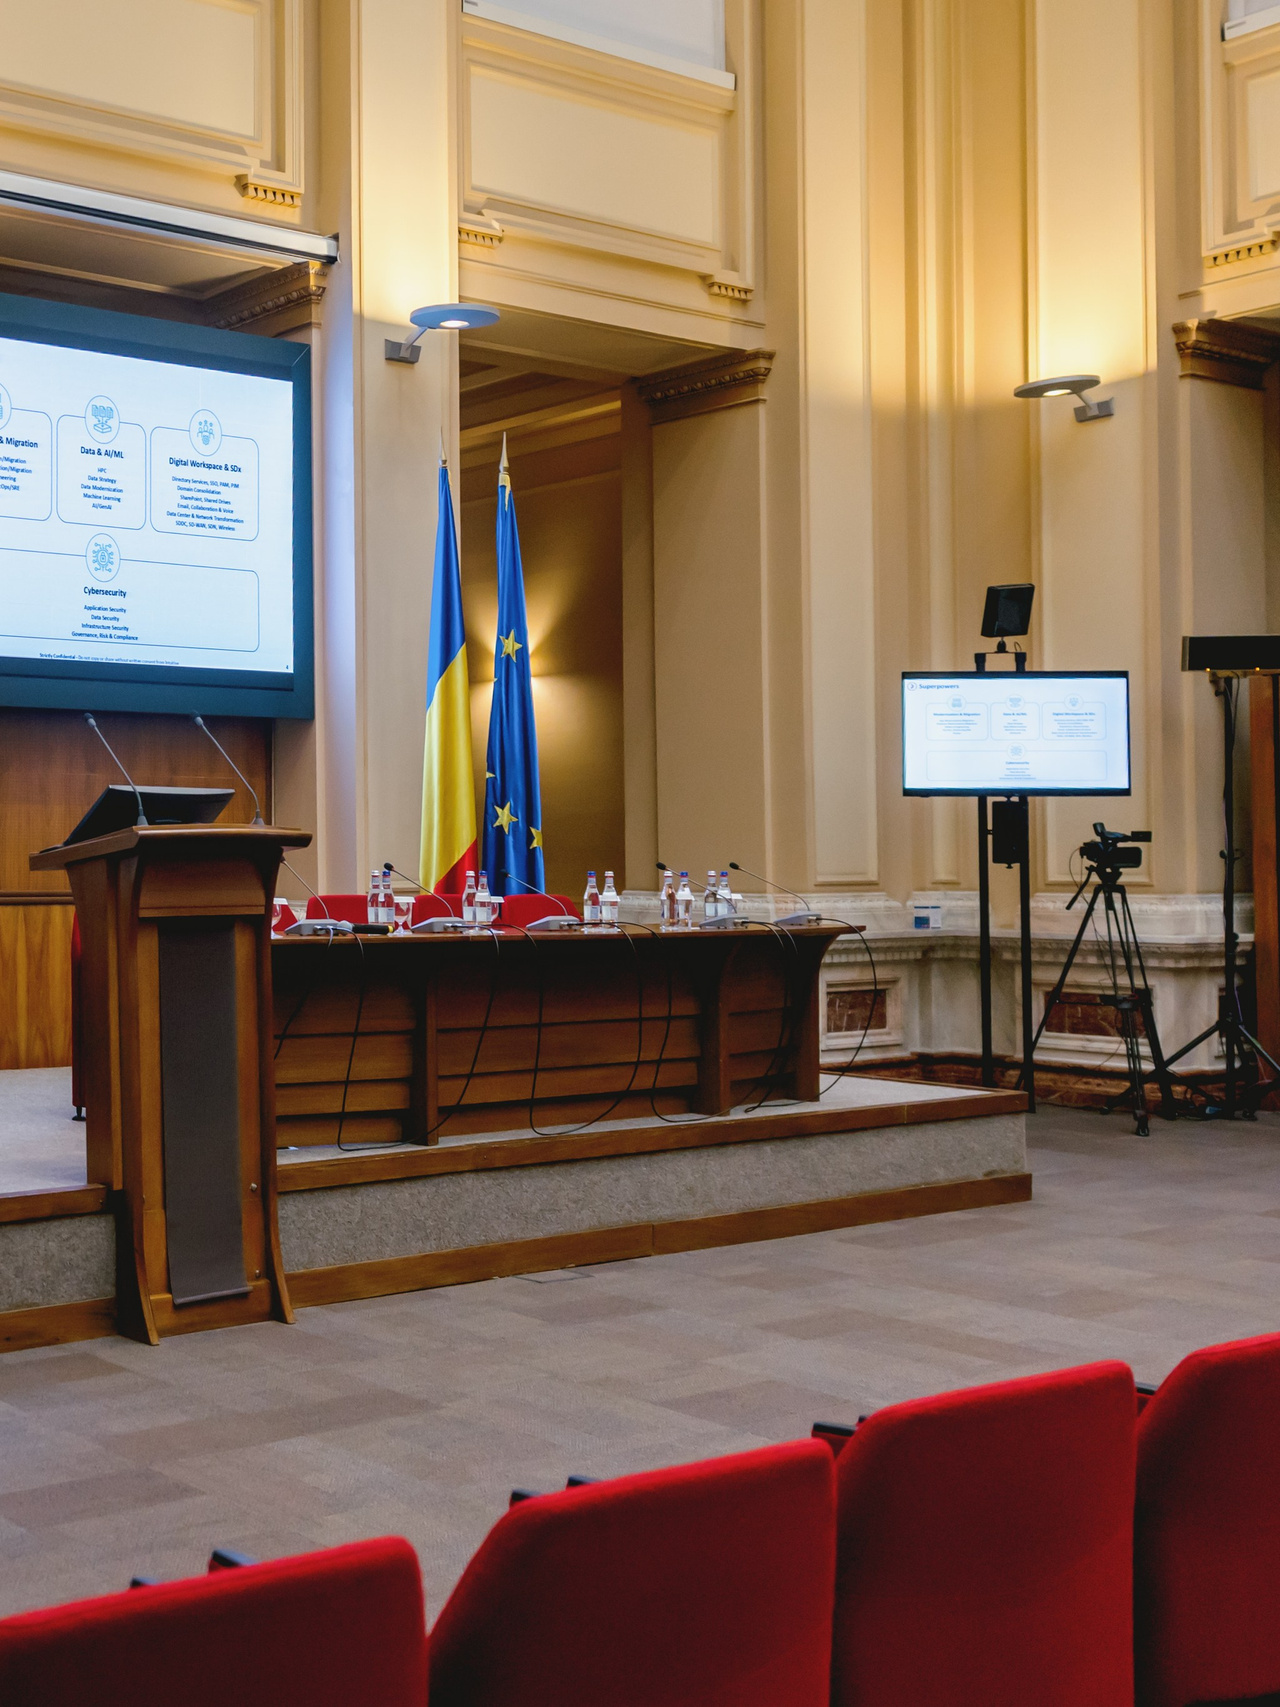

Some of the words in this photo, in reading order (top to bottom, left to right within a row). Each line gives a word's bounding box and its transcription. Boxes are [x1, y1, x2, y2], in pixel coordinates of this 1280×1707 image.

[5, 437, 38, 448] Migration
[80, 446, 95, 455] Data
[97, 448, 102, 456] &
[104, 449, 124, 459] AI/ML
[169, 457, 189, 467] Digital
[190, 460, 223, 471] Workspace
[230, 465, 242, 473] SDx
[83, 586, 127, 599] Cybersecurity
